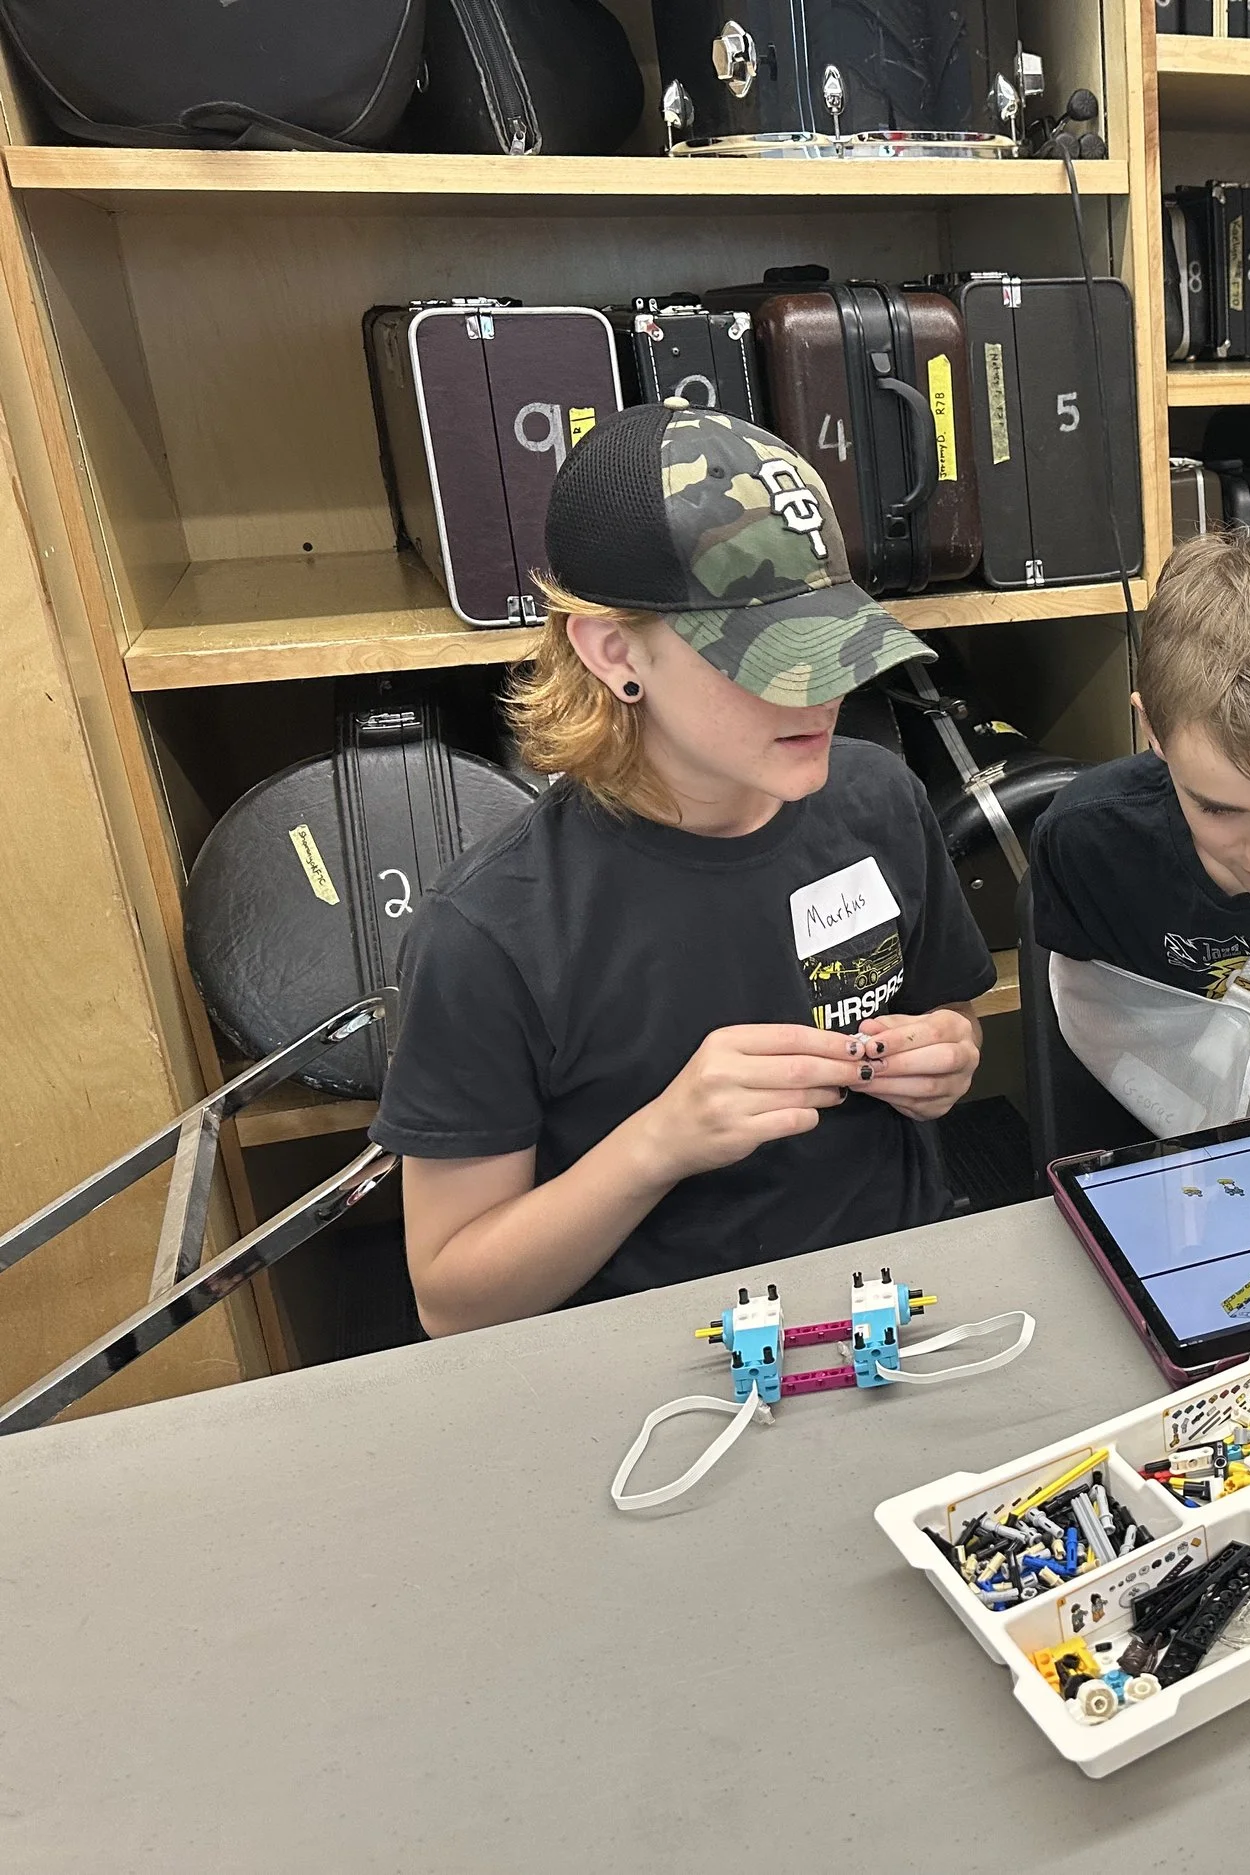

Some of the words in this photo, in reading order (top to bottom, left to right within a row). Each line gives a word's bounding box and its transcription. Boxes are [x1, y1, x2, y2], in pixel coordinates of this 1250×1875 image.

[1055, 392, 1081, 433] 5
[818, 413, 853, 463] 4
[379, 868, 413, 918] 2
[806, 892, 867, 938] Markus
[1202, 942, 1243, 962] Jazz
